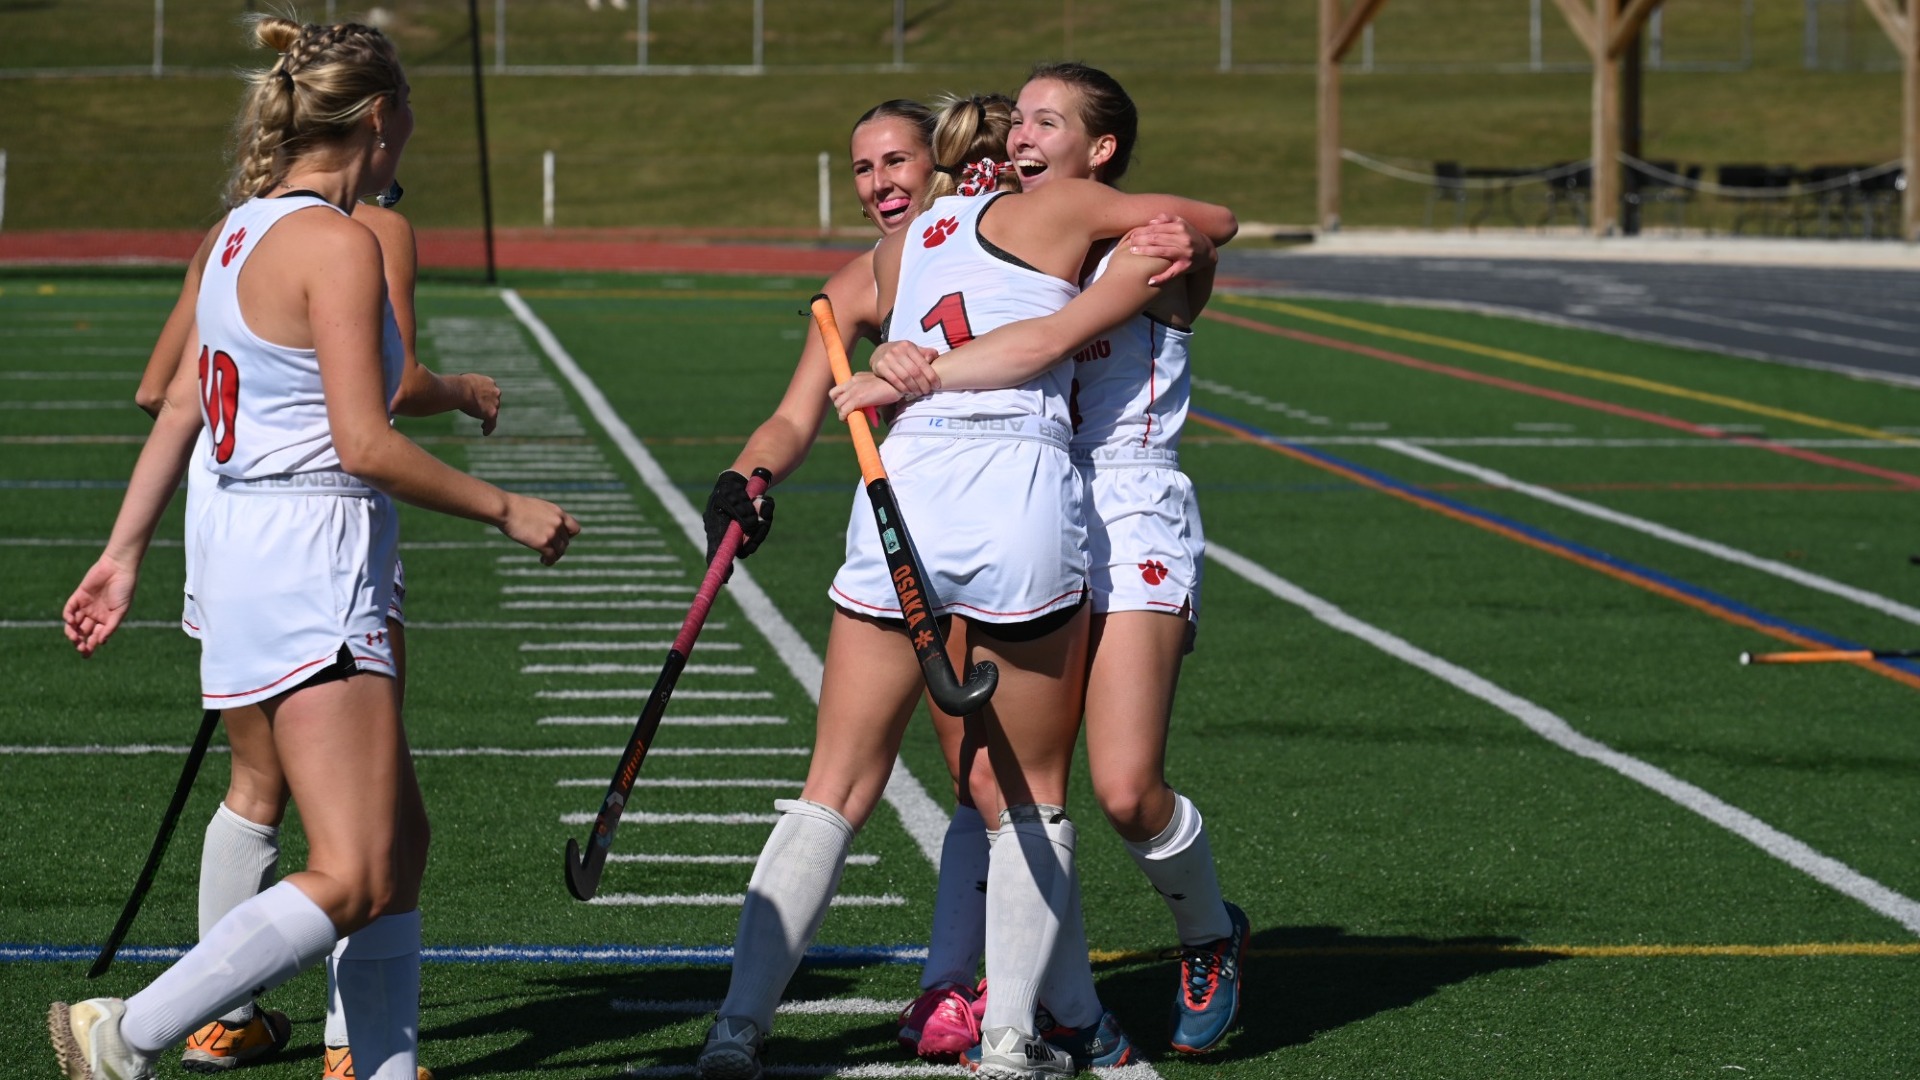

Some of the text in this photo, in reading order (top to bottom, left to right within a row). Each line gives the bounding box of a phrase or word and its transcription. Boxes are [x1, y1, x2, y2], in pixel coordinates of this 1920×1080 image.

[920, 291, 975, 349] 1
[893, 564, 927, 631] OSAKA
[621, 739, 645, 790] ritual
[1024, 1043, 1057, 1062] OSAKA
